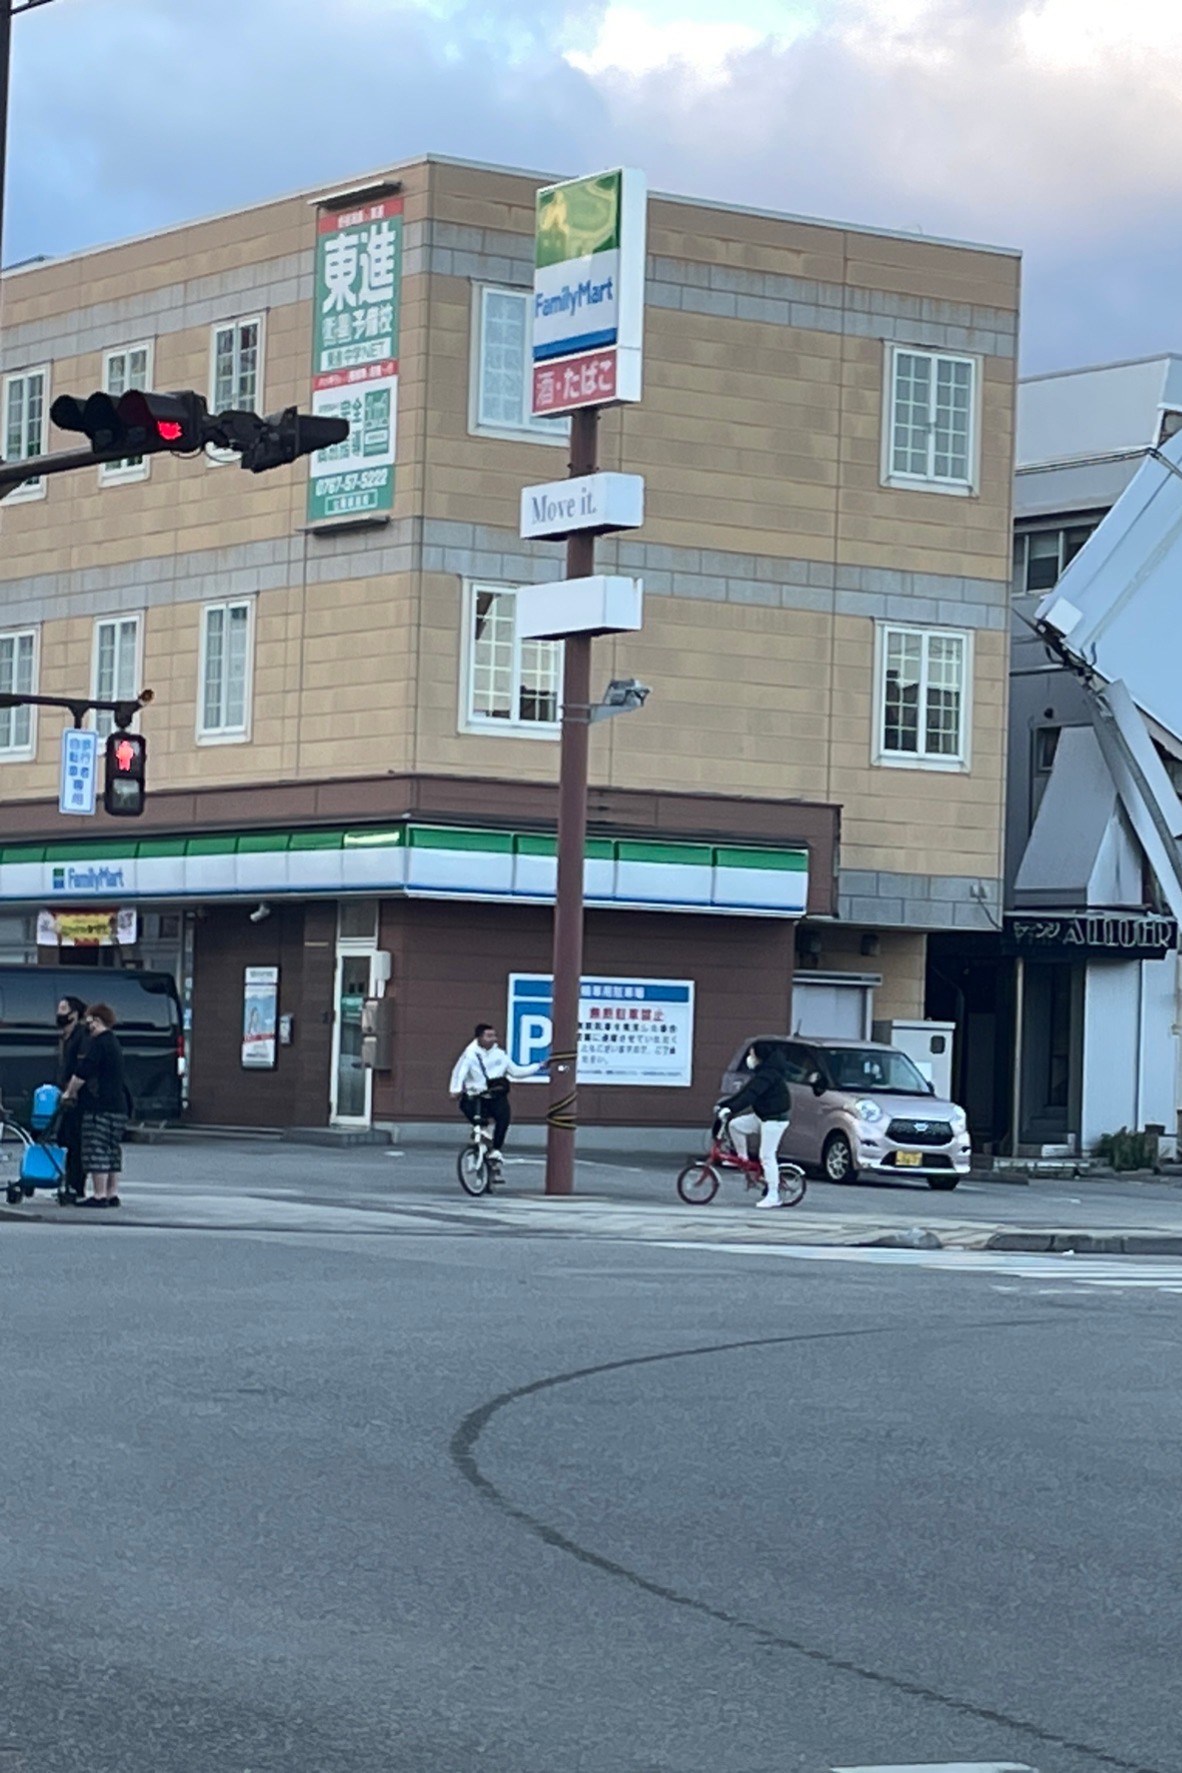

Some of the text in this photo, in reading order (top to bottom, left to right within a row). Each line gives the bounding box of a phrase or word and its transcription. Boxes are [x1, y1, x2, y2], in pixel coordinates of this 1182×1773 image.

[322, 221, 396, 312] 東進
[534, 275, 615, 319] FamilyMart
[537, 360, 613, 406] 酒・たばこ
[532, 487, 598, 525] Move it.
[68, 867, 124, 892] FamilyMart
[520, 1014, 552, 1064] P
